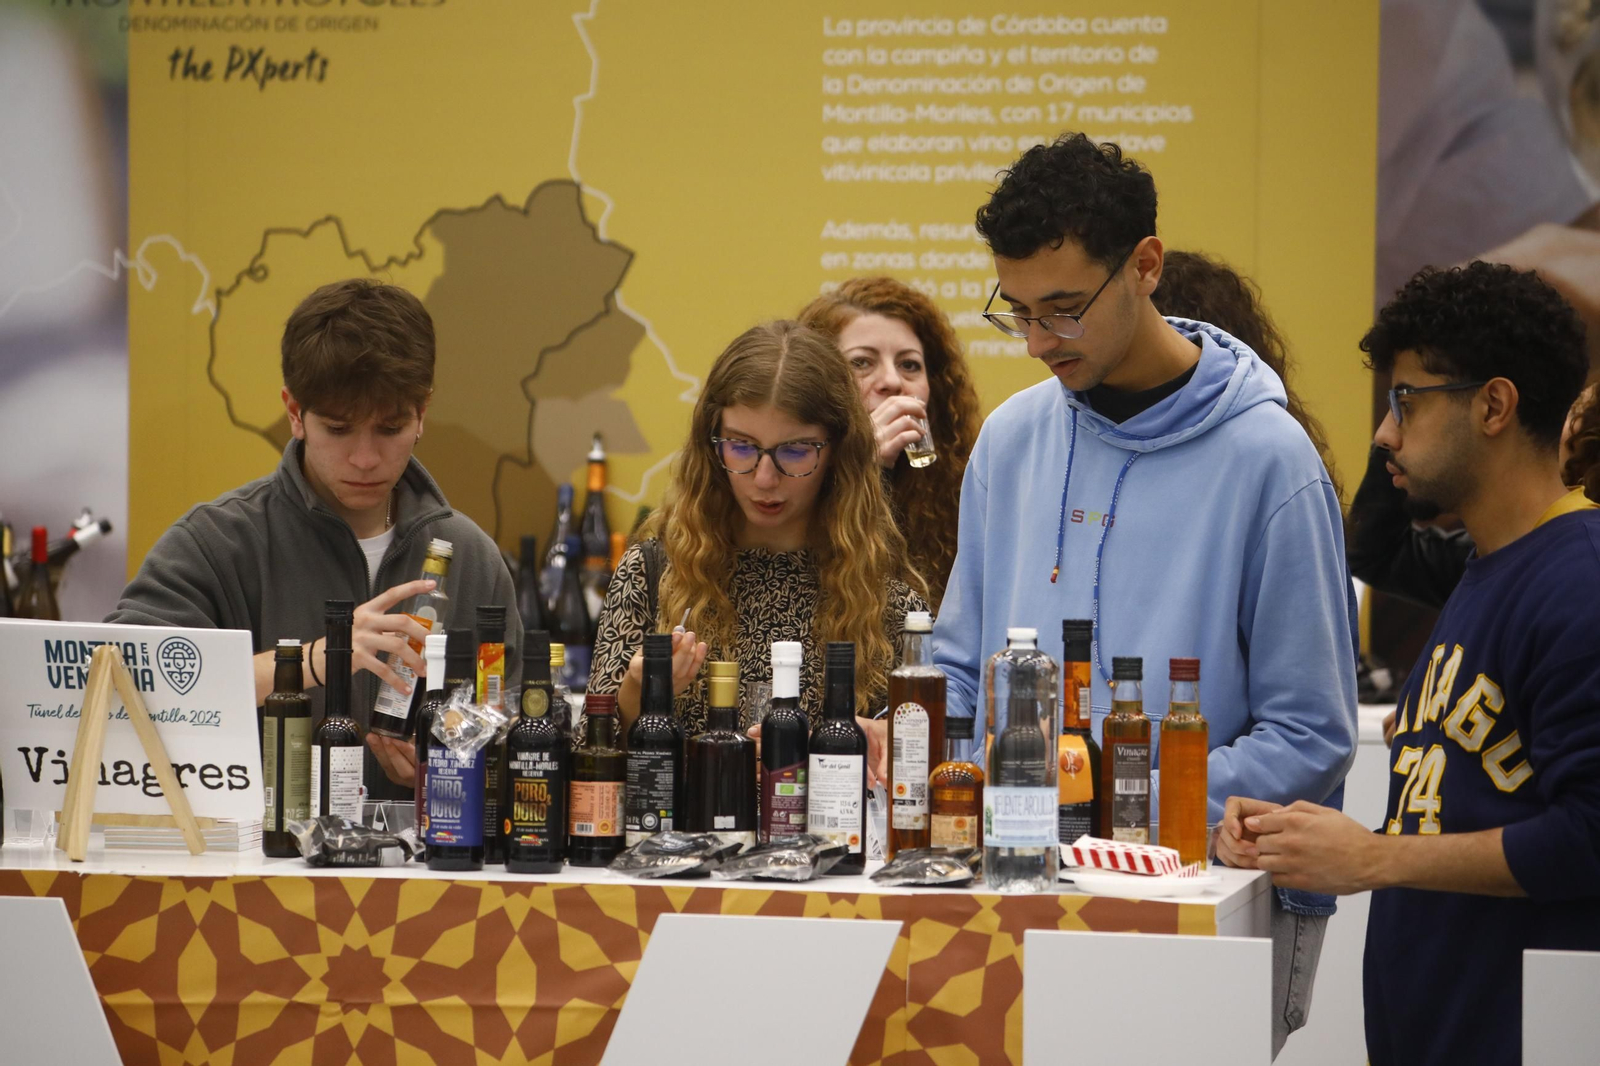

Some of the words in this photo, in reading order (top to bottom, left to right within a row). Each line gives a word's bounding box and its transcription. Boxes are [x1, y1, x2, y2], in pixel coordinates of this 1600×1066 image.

[118, 15, 269, 33] DENOMINACIÓN
[274, 15, 300, 32] DE
[304, 15, 379, 33] ORIGEN
[823, 18, 853, 36] La
[855, 16, 953, 40] provincia
[958, 16, 986, 35] de
[990, 13, 1087, 35] Córdoba
[1091, 17, 1169, 34] cuenta
[823, 48, 865, 66] con
[867, 45, 889, 65] la
[890, 46, 986, 68] campiña
[988, 49, 1001, 68] y
[1006, 45, 1028, 64] el
[1030, 44, 1126, 64] territorio
[1128, 43, 1159, 64] de
[169, 45, 215, 81] the
[221, 43, 331, 92] PXperts
[823, 75, 844, 94] la
[847, 72, 1001, 95] Denominación
[1004, 74, 1035, 94] de
[1037, 73, 1113, 97] Origen
[1117, 73, 1148, 93] de
[1001, 106, 1043, 123] con
[1046, 103, 1074, 122] 17
[1077, 103, 1194, 125] municipios
[822, 136, 862, 156] que
[866, 133, 964, 153] elaboran
[968, 133, 1014, 152] vino
[821, 220, 914, 242] Además,
[821, 253, 849, 270] en
[852, 252, 917, 270] zonas
[919, 250, 990, 270] donde
[189, 710, 222, 726] 2025
[542, 752, 550, 761] DE
[432, 780, 462, 799] PURO
[514, 783, 548, 802] PURO
[1386, 743, 1447, 835] 74
[431, 799, 462, 818] DURO
[514, 801, 546, 822] DURO
